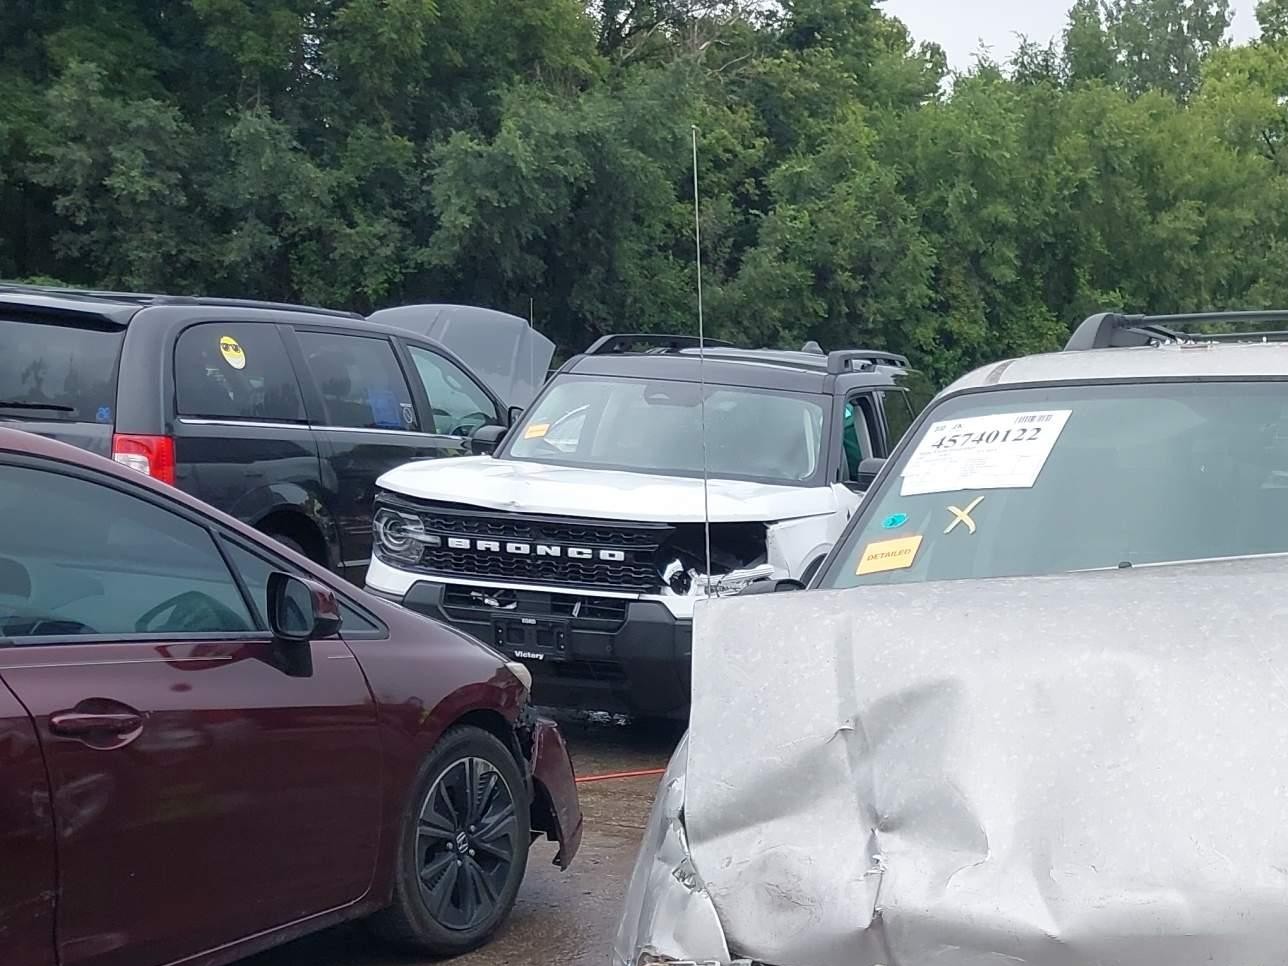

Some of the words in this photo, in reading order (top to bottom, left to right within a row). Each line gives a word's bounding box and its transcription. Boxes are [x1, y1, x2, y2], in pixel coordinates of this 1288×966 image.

[931, 427, 1042, 449] 45740122
[447, 536, 626, 562] BRONCO
[867, 548, 912, 560] DETAILED
